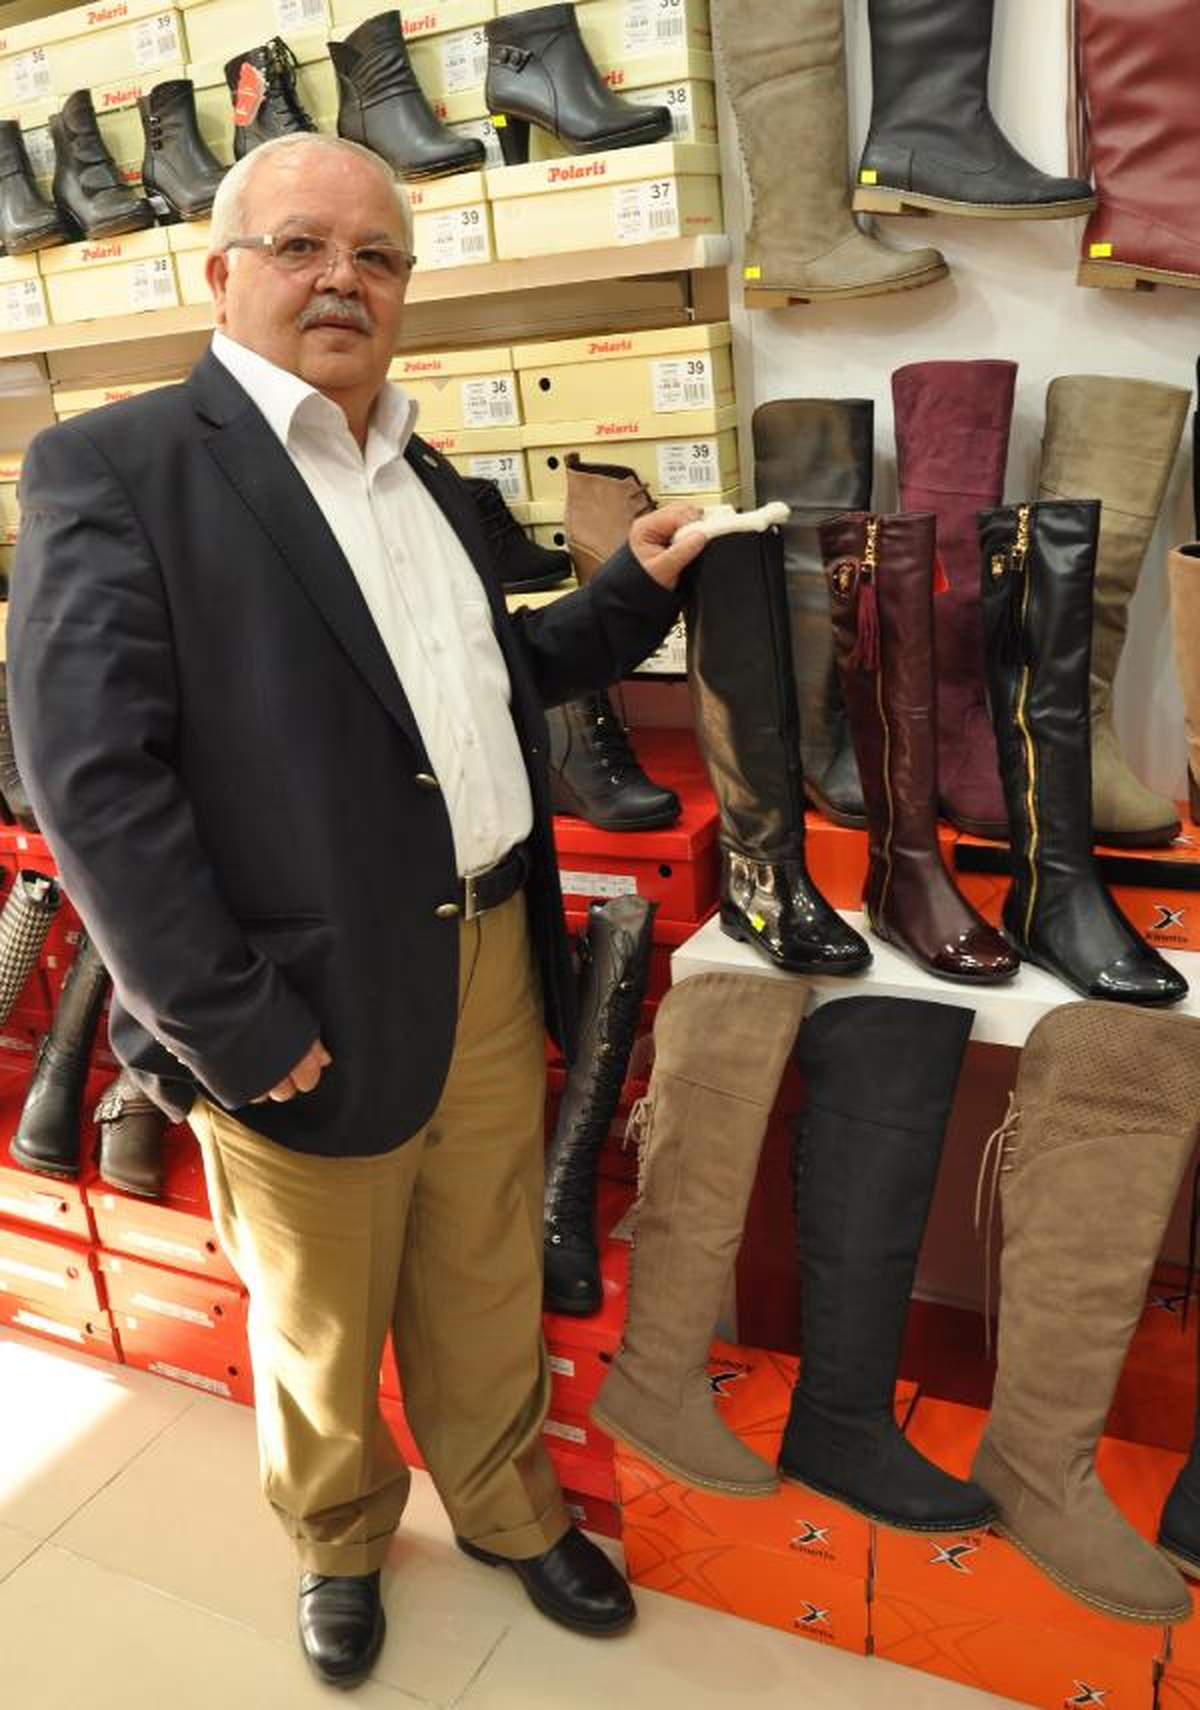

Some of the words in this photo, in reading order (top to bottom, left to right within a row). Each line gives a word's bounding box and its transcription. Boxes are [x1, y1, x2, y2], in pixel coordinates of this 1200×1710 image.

[667, 87, 687, 105] 38
[548, 162, 606, 183] Polaris
[650, 183, 671, 199] 37
[461, 210, 479, 225] 39
[587, 340, 632, 354] Polaris
[687, 361, 705, 375] 39
[596, 423, 639, 435] Polaris
[692, 444, 709, 459] 39
[499, 457, 512, 470] 37
